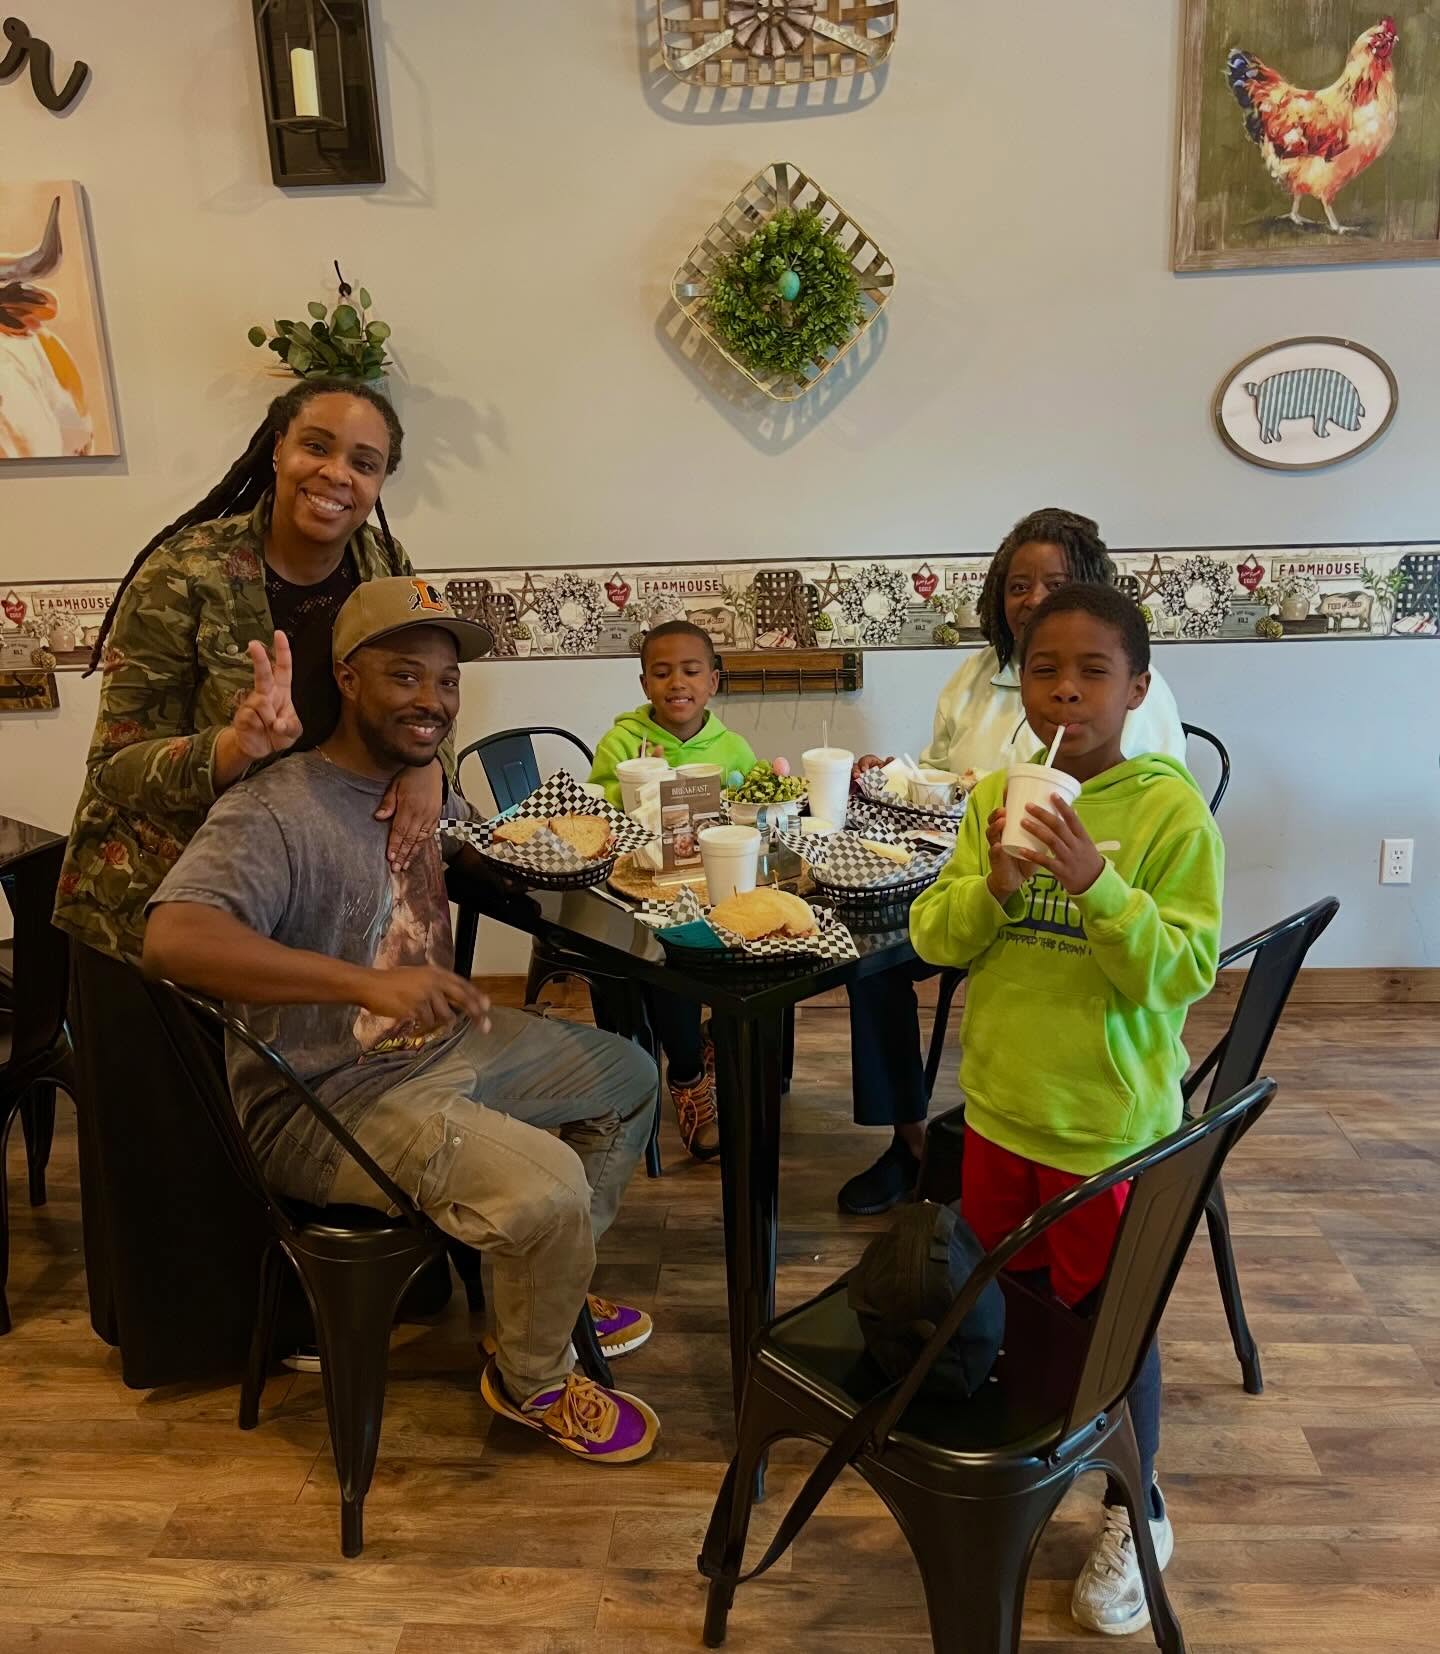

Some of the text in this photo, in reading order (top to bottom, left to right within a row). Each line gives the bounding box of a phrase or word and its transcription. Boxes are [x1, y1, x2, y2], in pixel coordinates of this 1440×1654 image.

[1279, 562, 1361, 576] FARMHOUSE
[644, 580, 719, 593] FARMHOUSE
[39, 597, 111, 610] FARMHOUSE
[671, 784, 709, 797] BREAKFAST
